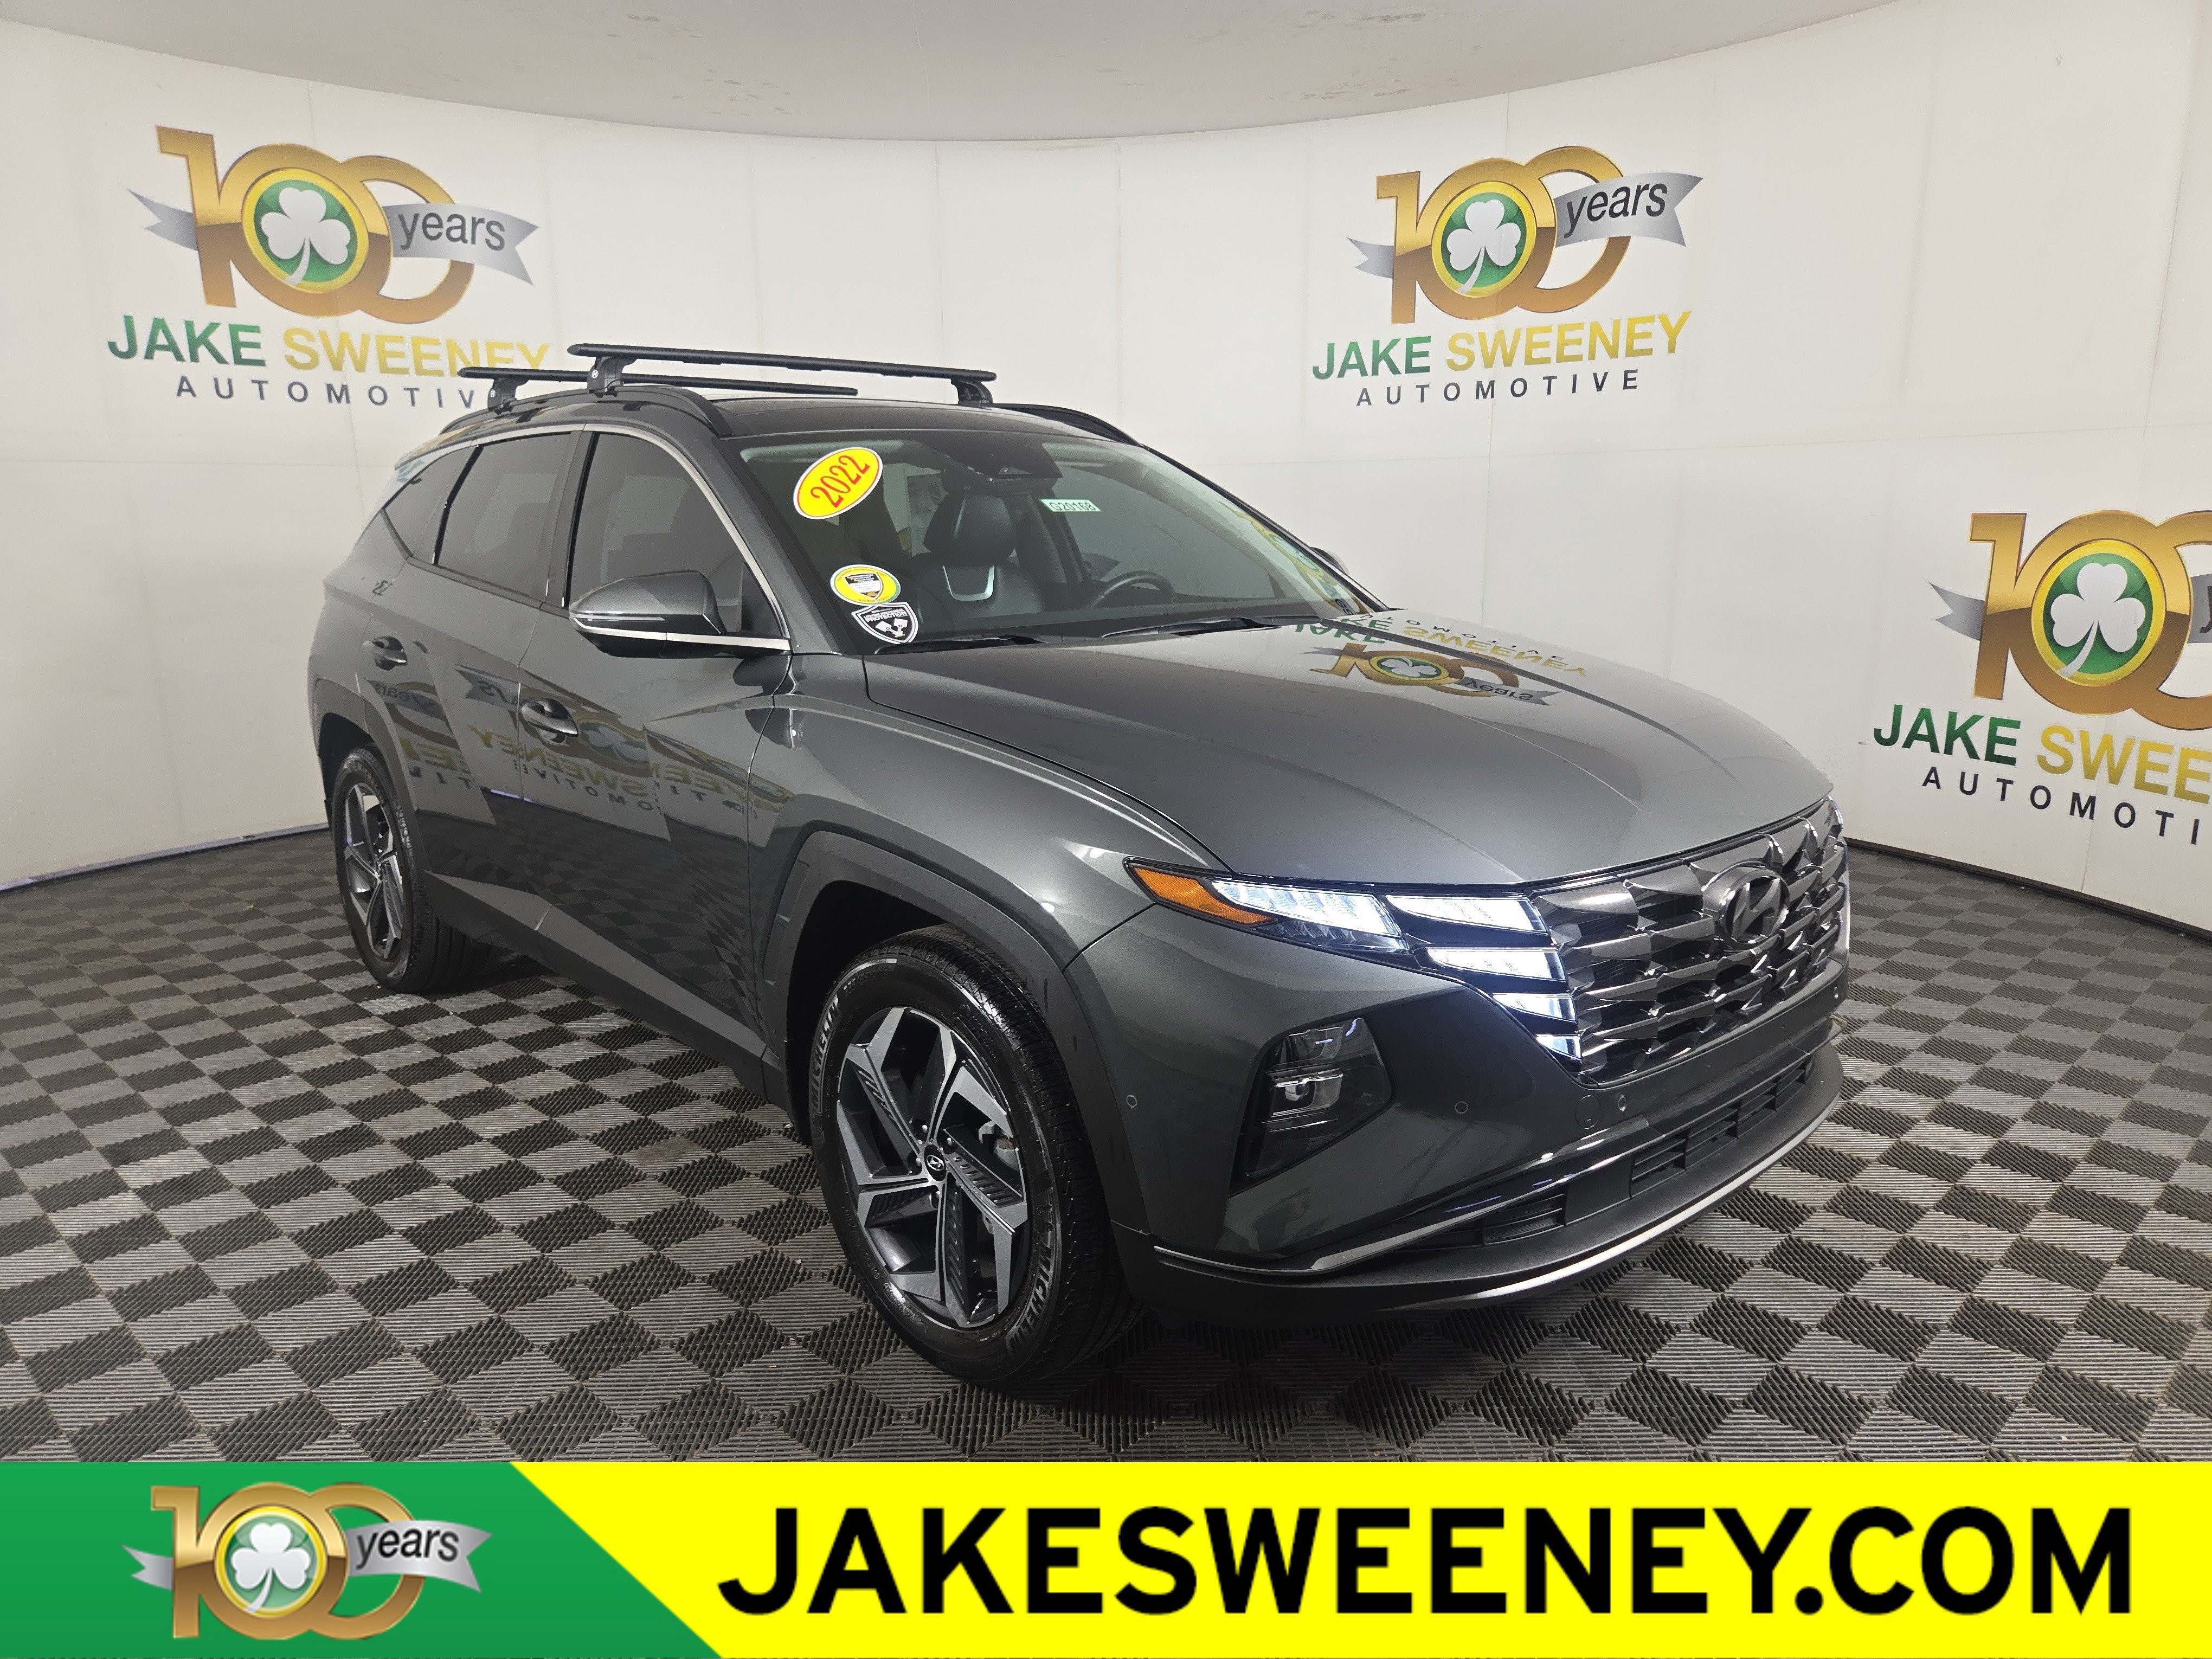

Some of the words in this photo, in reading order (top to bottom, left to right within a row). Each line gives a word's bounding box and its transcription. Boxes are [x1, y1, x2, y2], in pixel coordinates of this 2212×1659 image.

[155, 125, 475, 324] 100
[398, 212, 506, 252] years
[1376, 145, 1631, 324] 100
[1564, 183, 1668, 239] years
[107, 314, 267, 368] JAKE
[1312, 336, 1432, 380] JAKE
[1446, 311, 1692, 372] SWEENEY
[176, 376, 474, 409] AUTOMOTIV
[1356, 369, 1638, 407] AUTOMOTIVE
[810, 455, 871, 508] 2022
[1049, 502, 1096, 511] G20168
[865, 610, 908, 623] PROTECTION
[1873, 704, 2021, 766] JAKE
[811, 1000, 838, 1110] MICHELIN
[1009, 1240, 1051, 1355] MICHELIN
